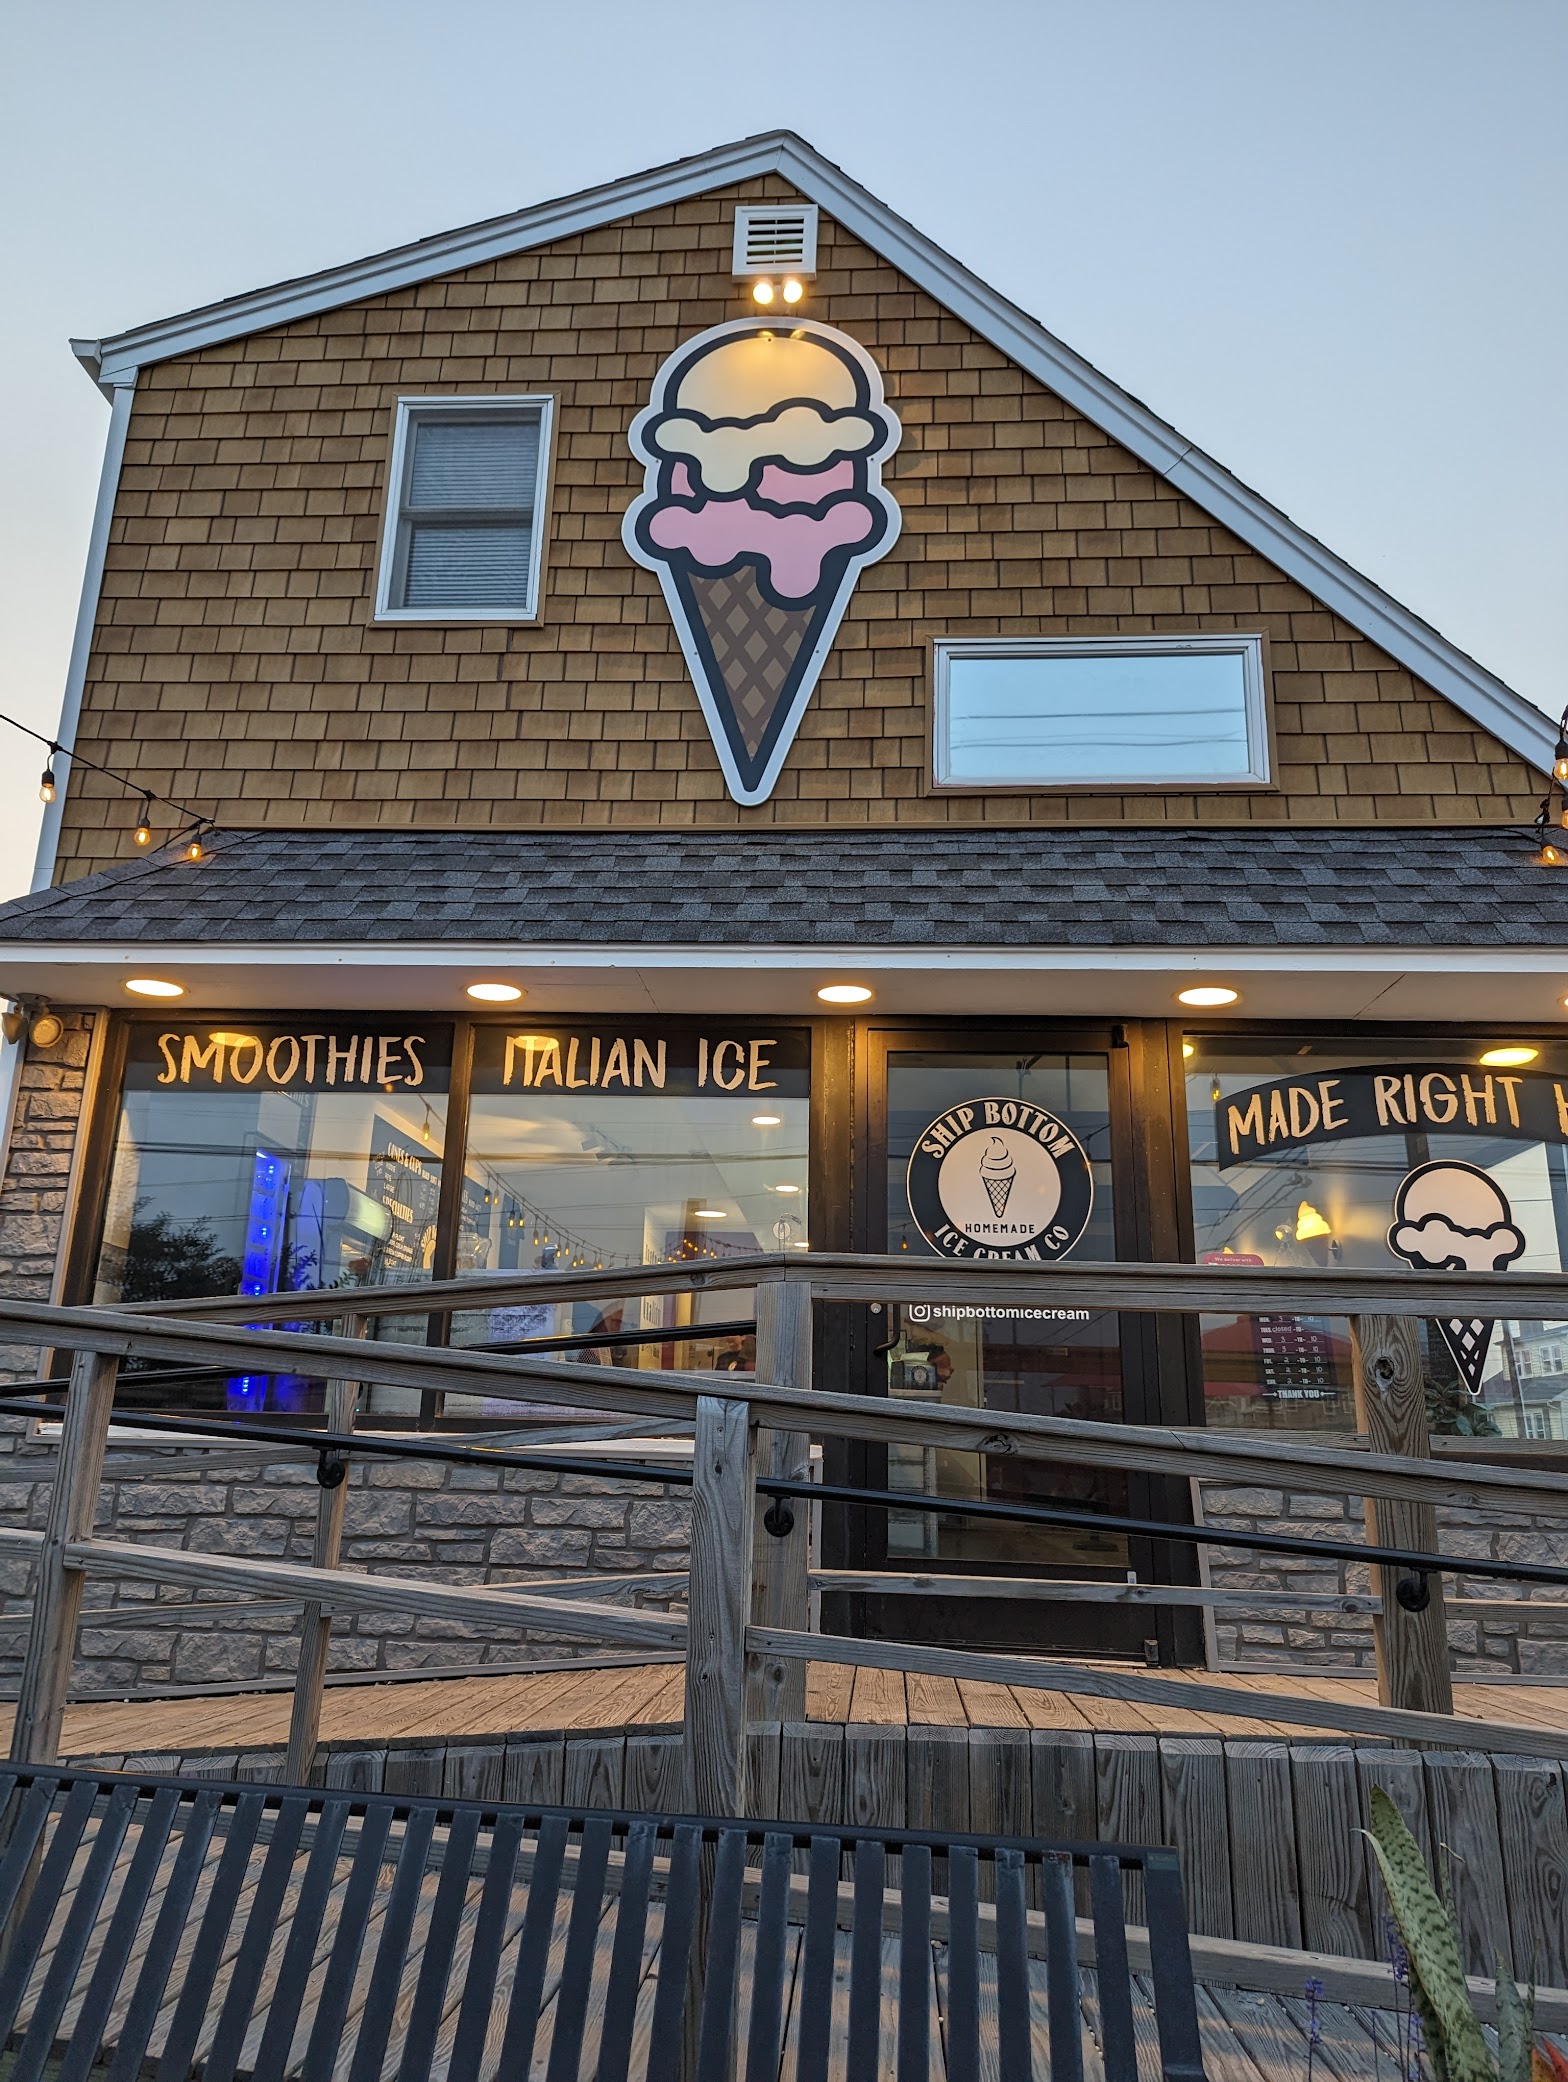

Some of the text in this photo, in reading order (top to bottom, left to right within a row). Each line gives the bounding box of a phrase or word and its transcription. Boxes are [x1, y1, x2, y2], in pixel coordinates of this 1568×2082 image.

[157, 1032, 426, 1086] SMOOTHIES
[503, 1035, 779, 1091] ITALIAN ICE
[921, 1101, 1075, 1159] SHIP BOTTOM
[1227, 1079, 1349, 1155] MADE
[1373, 1072, 1523, 1128] RIGHT
[409, 1155, 423, 1176] CUPS
[934, 1223, 969, 1257] ICE
[1044, 1225, 1070, 1251] CO
[965, 1223, 1035, 1234] HOMEMADE
[932, 1304, 1090, 1321] shipbottomicecream
[1276, 1389, 1321, 1399] THANK YOU
